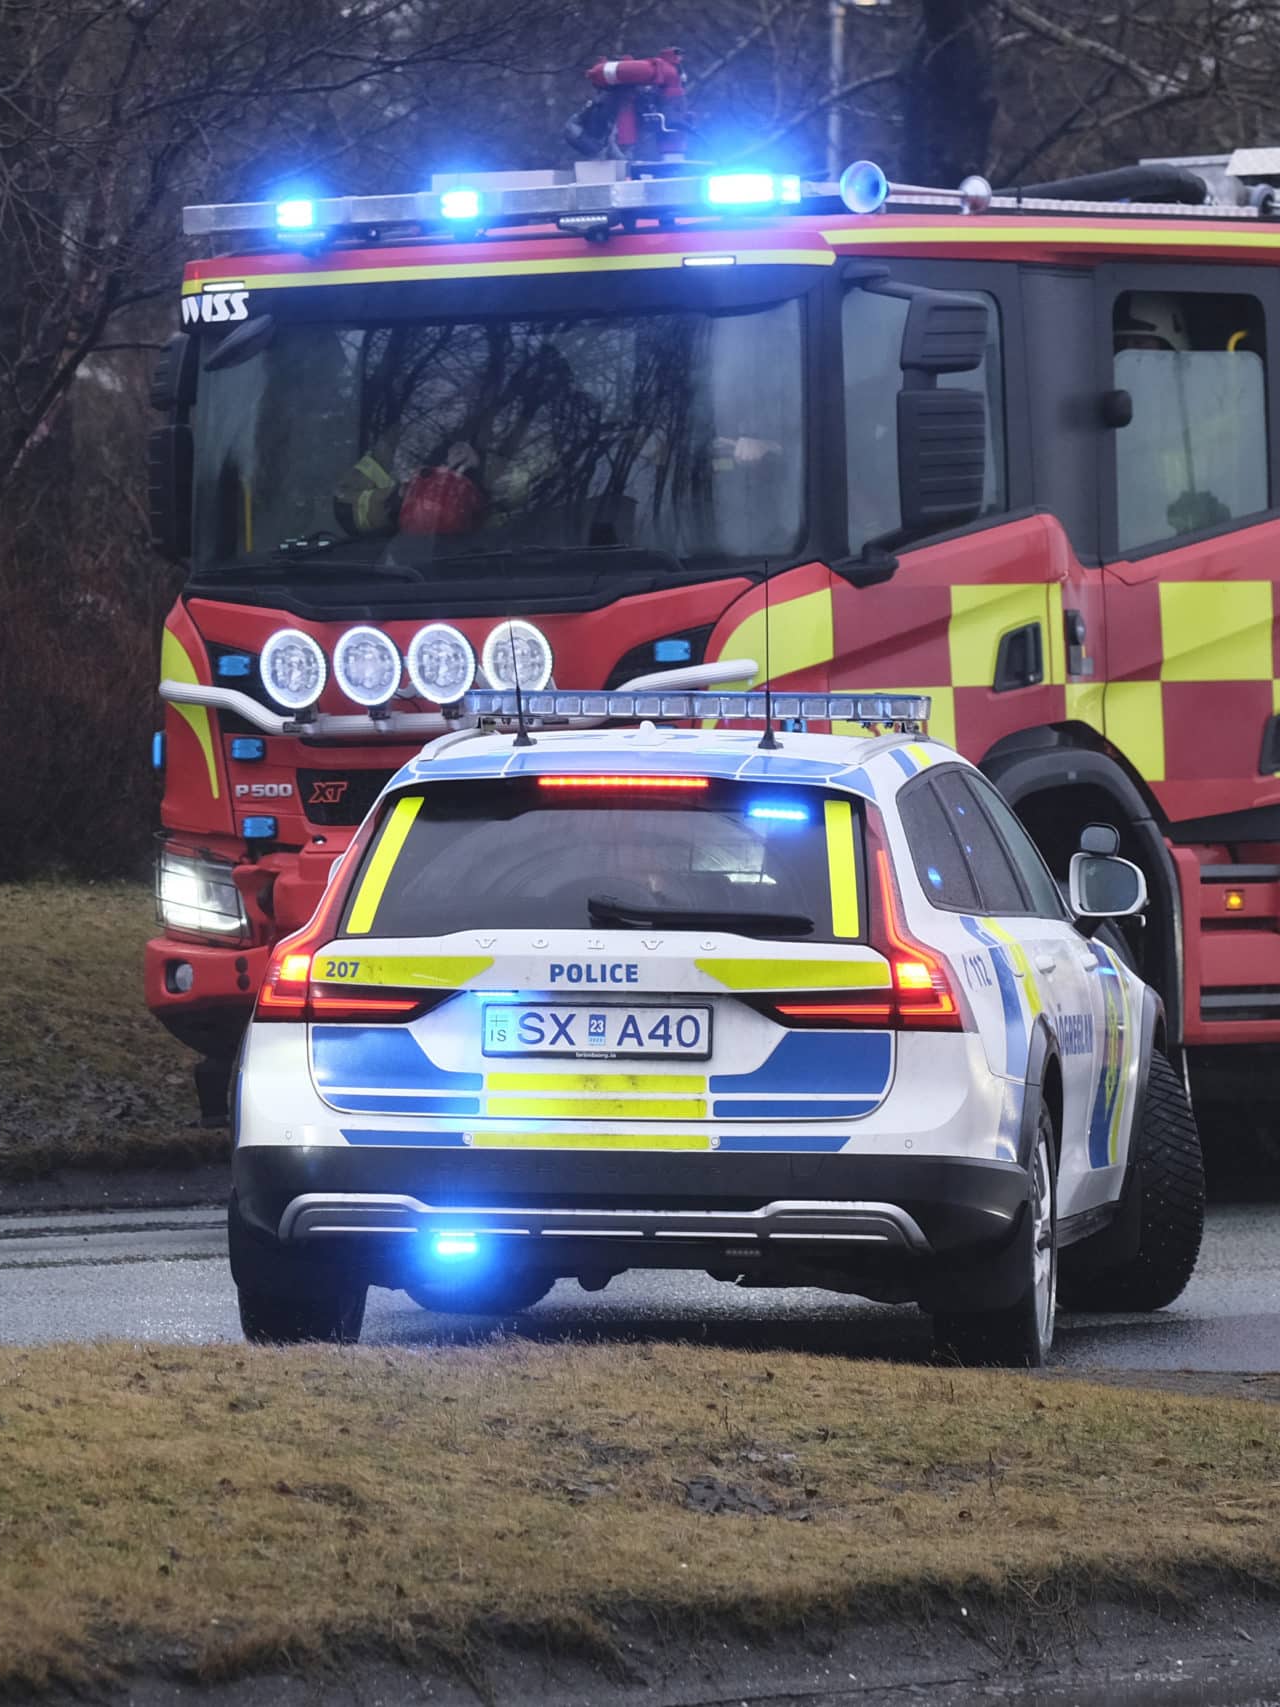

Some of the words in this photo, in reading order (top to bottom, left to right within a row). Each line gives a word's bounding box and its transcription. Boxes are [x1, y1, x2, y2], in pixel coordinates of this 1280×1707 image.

[309, 781, 348, 803] XT
[326, 961, 360, 978] 207
[550, 963, 639, 984] POLICE
[489, 1029, 507, 1042] IS
[517, 1011, 576, 1046] SX
[617, 1014, 701, 1047] A40
[590, 1019, 604, 1033] 23
